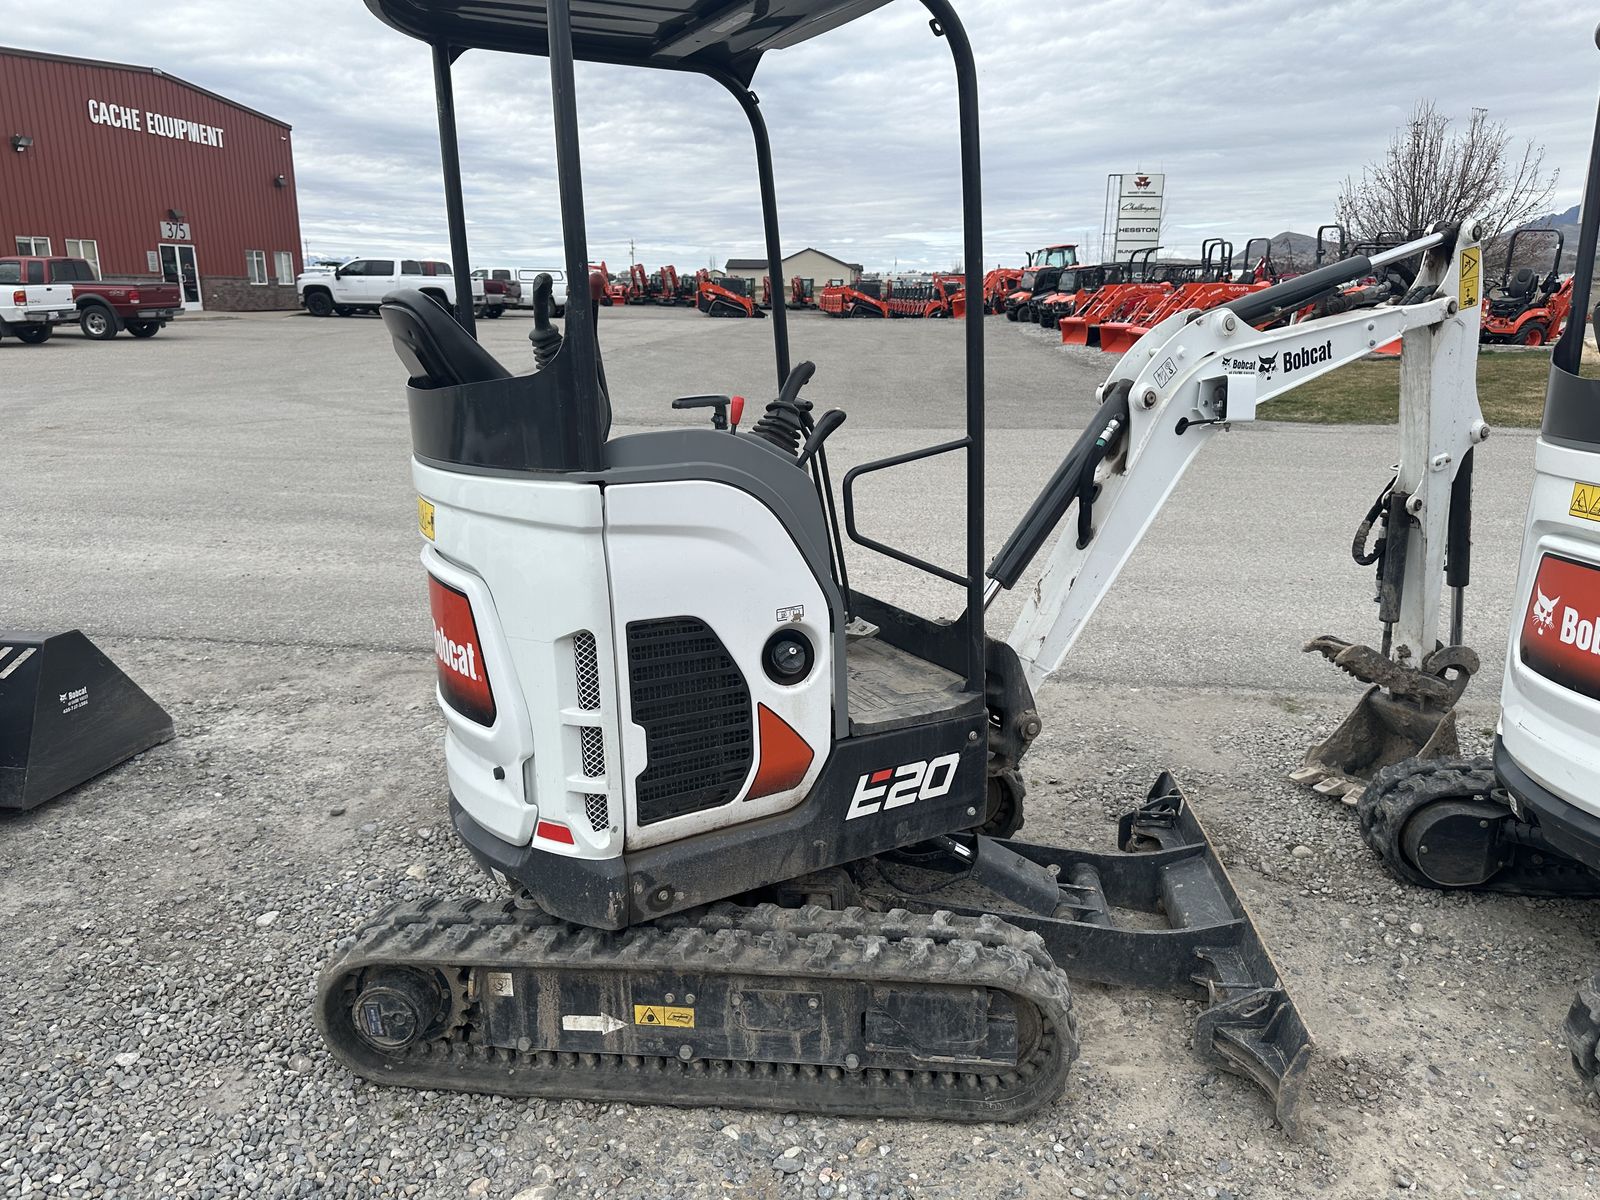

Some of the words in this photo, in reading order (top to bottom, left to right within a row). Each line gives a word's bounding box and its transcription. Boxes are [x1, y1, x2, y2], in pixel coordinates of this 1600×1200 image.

[88, 99, 142, 132] CACHE
[145, 111, 224, 149] EQUIPMENT
[166, 222, 186, 239] 375
[1232, 359, 1256, 370] Bobcat
[1283, 339, 1332, 373] Bobcat
[68, 686, 88, 700] Bobcat
[845, 752, 960, 821] E20
